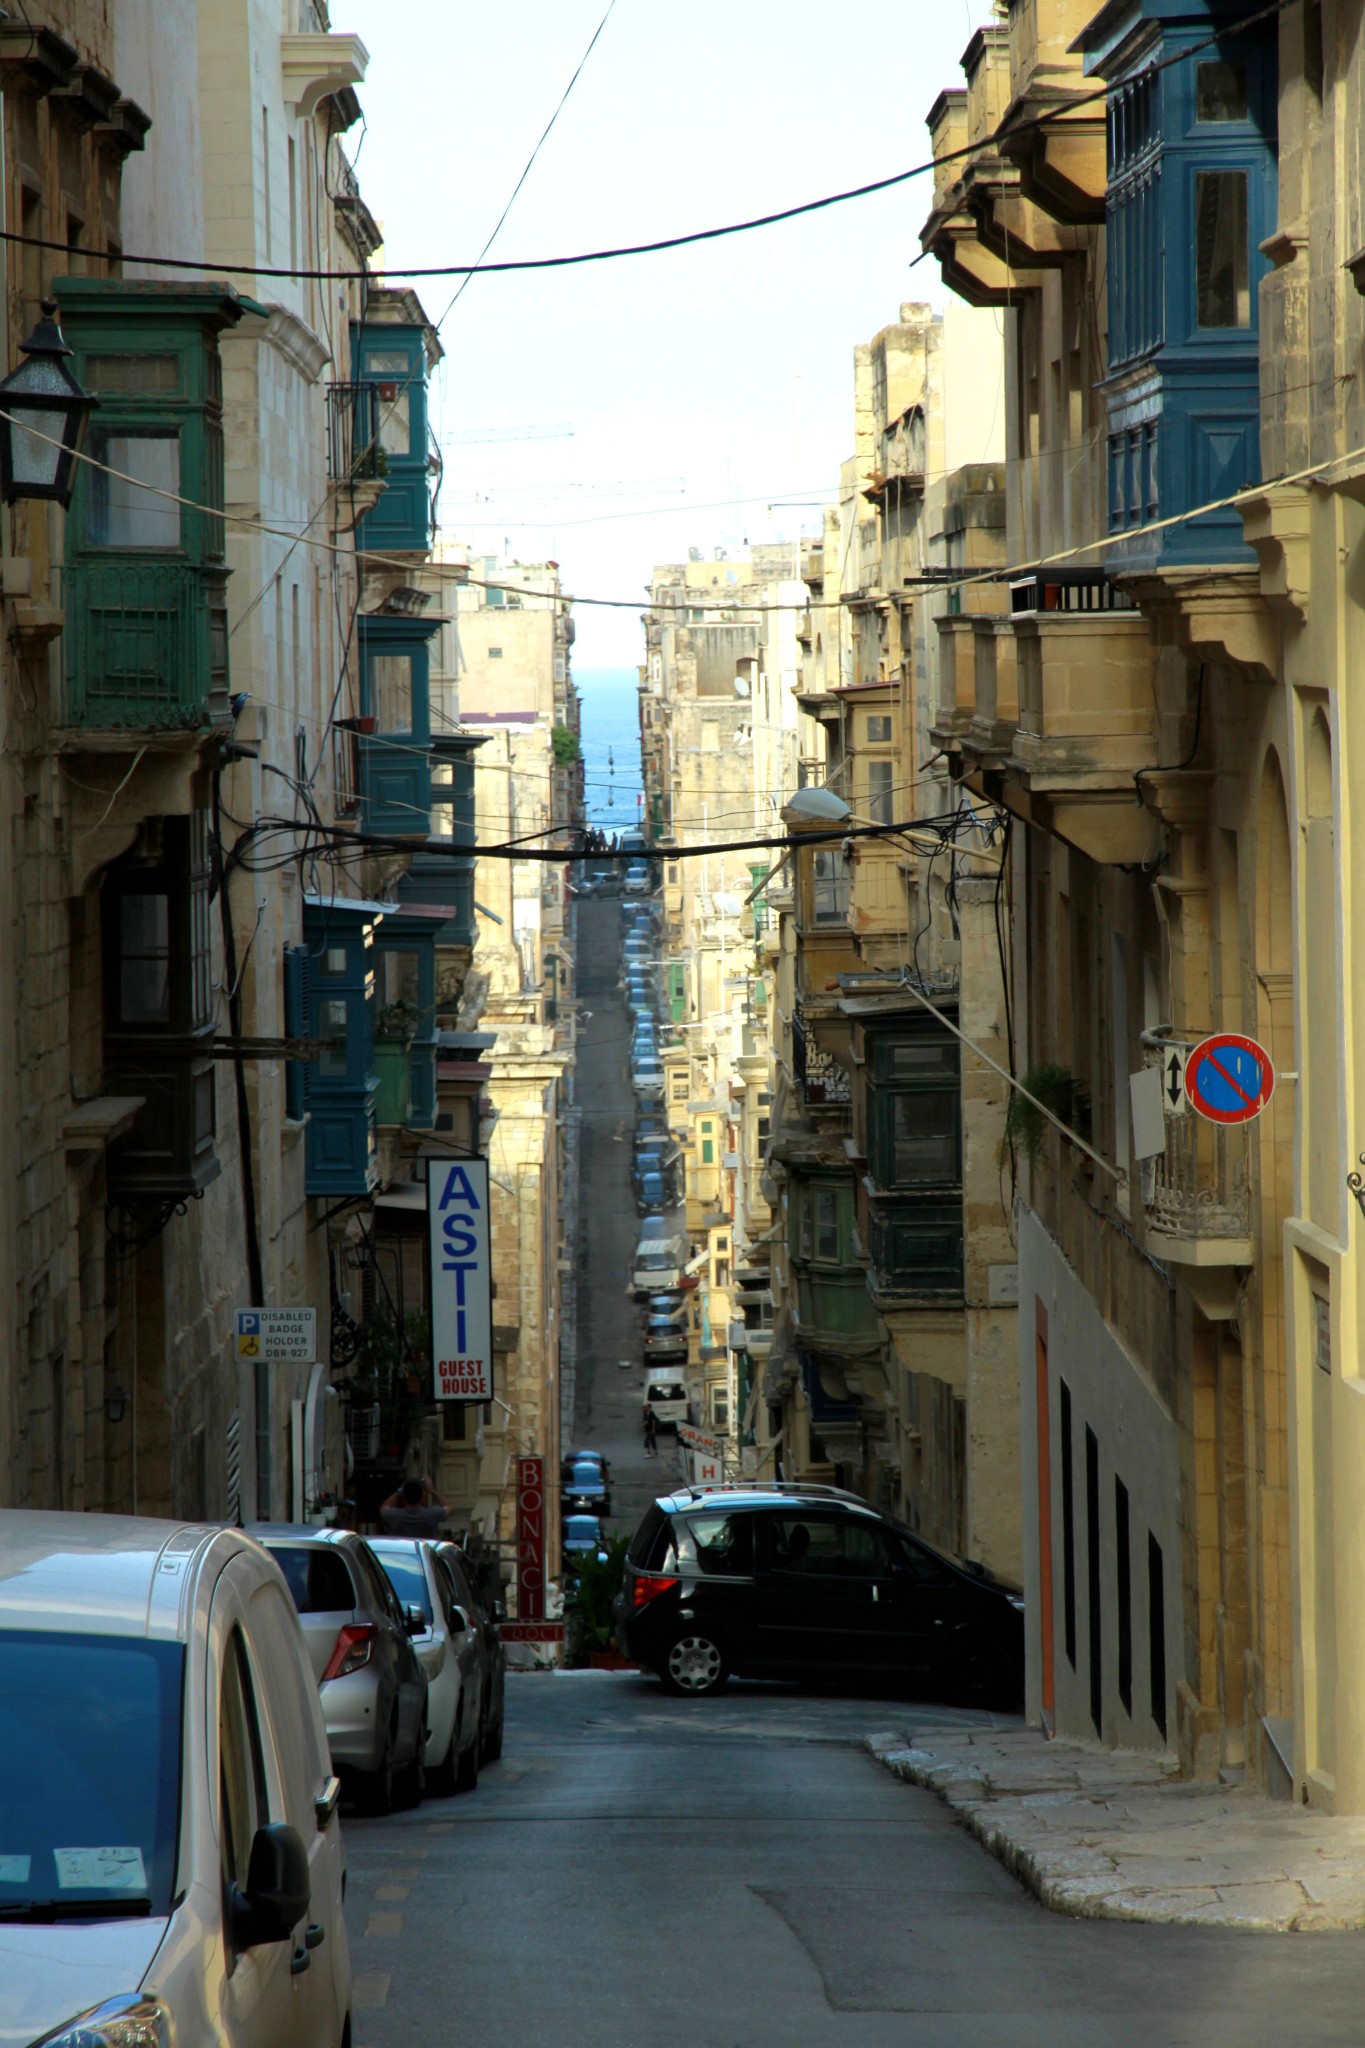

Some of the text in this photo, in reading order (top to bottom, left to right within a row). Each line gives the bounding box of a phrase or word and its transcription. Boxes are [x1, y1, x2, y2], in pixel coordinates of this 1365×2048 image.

[438, 1165, 481, 1354] ASTI
[242, 1315, 256, 1334] P
[261, 1312, 312, 1321] DISABLED
[268, 1324, 304, 1333] BADGE
[265, 1336, 308, 1345] HOLDER
[265, 1348, 308, 1357] DBR-927
[438, 1359, 484, 1377] GUEST
[441, 1377, 487, 1395] HOUSE
[679, 1428, 721, 1450] GRAND
[519, 1461, 542, 1616] BONACI
